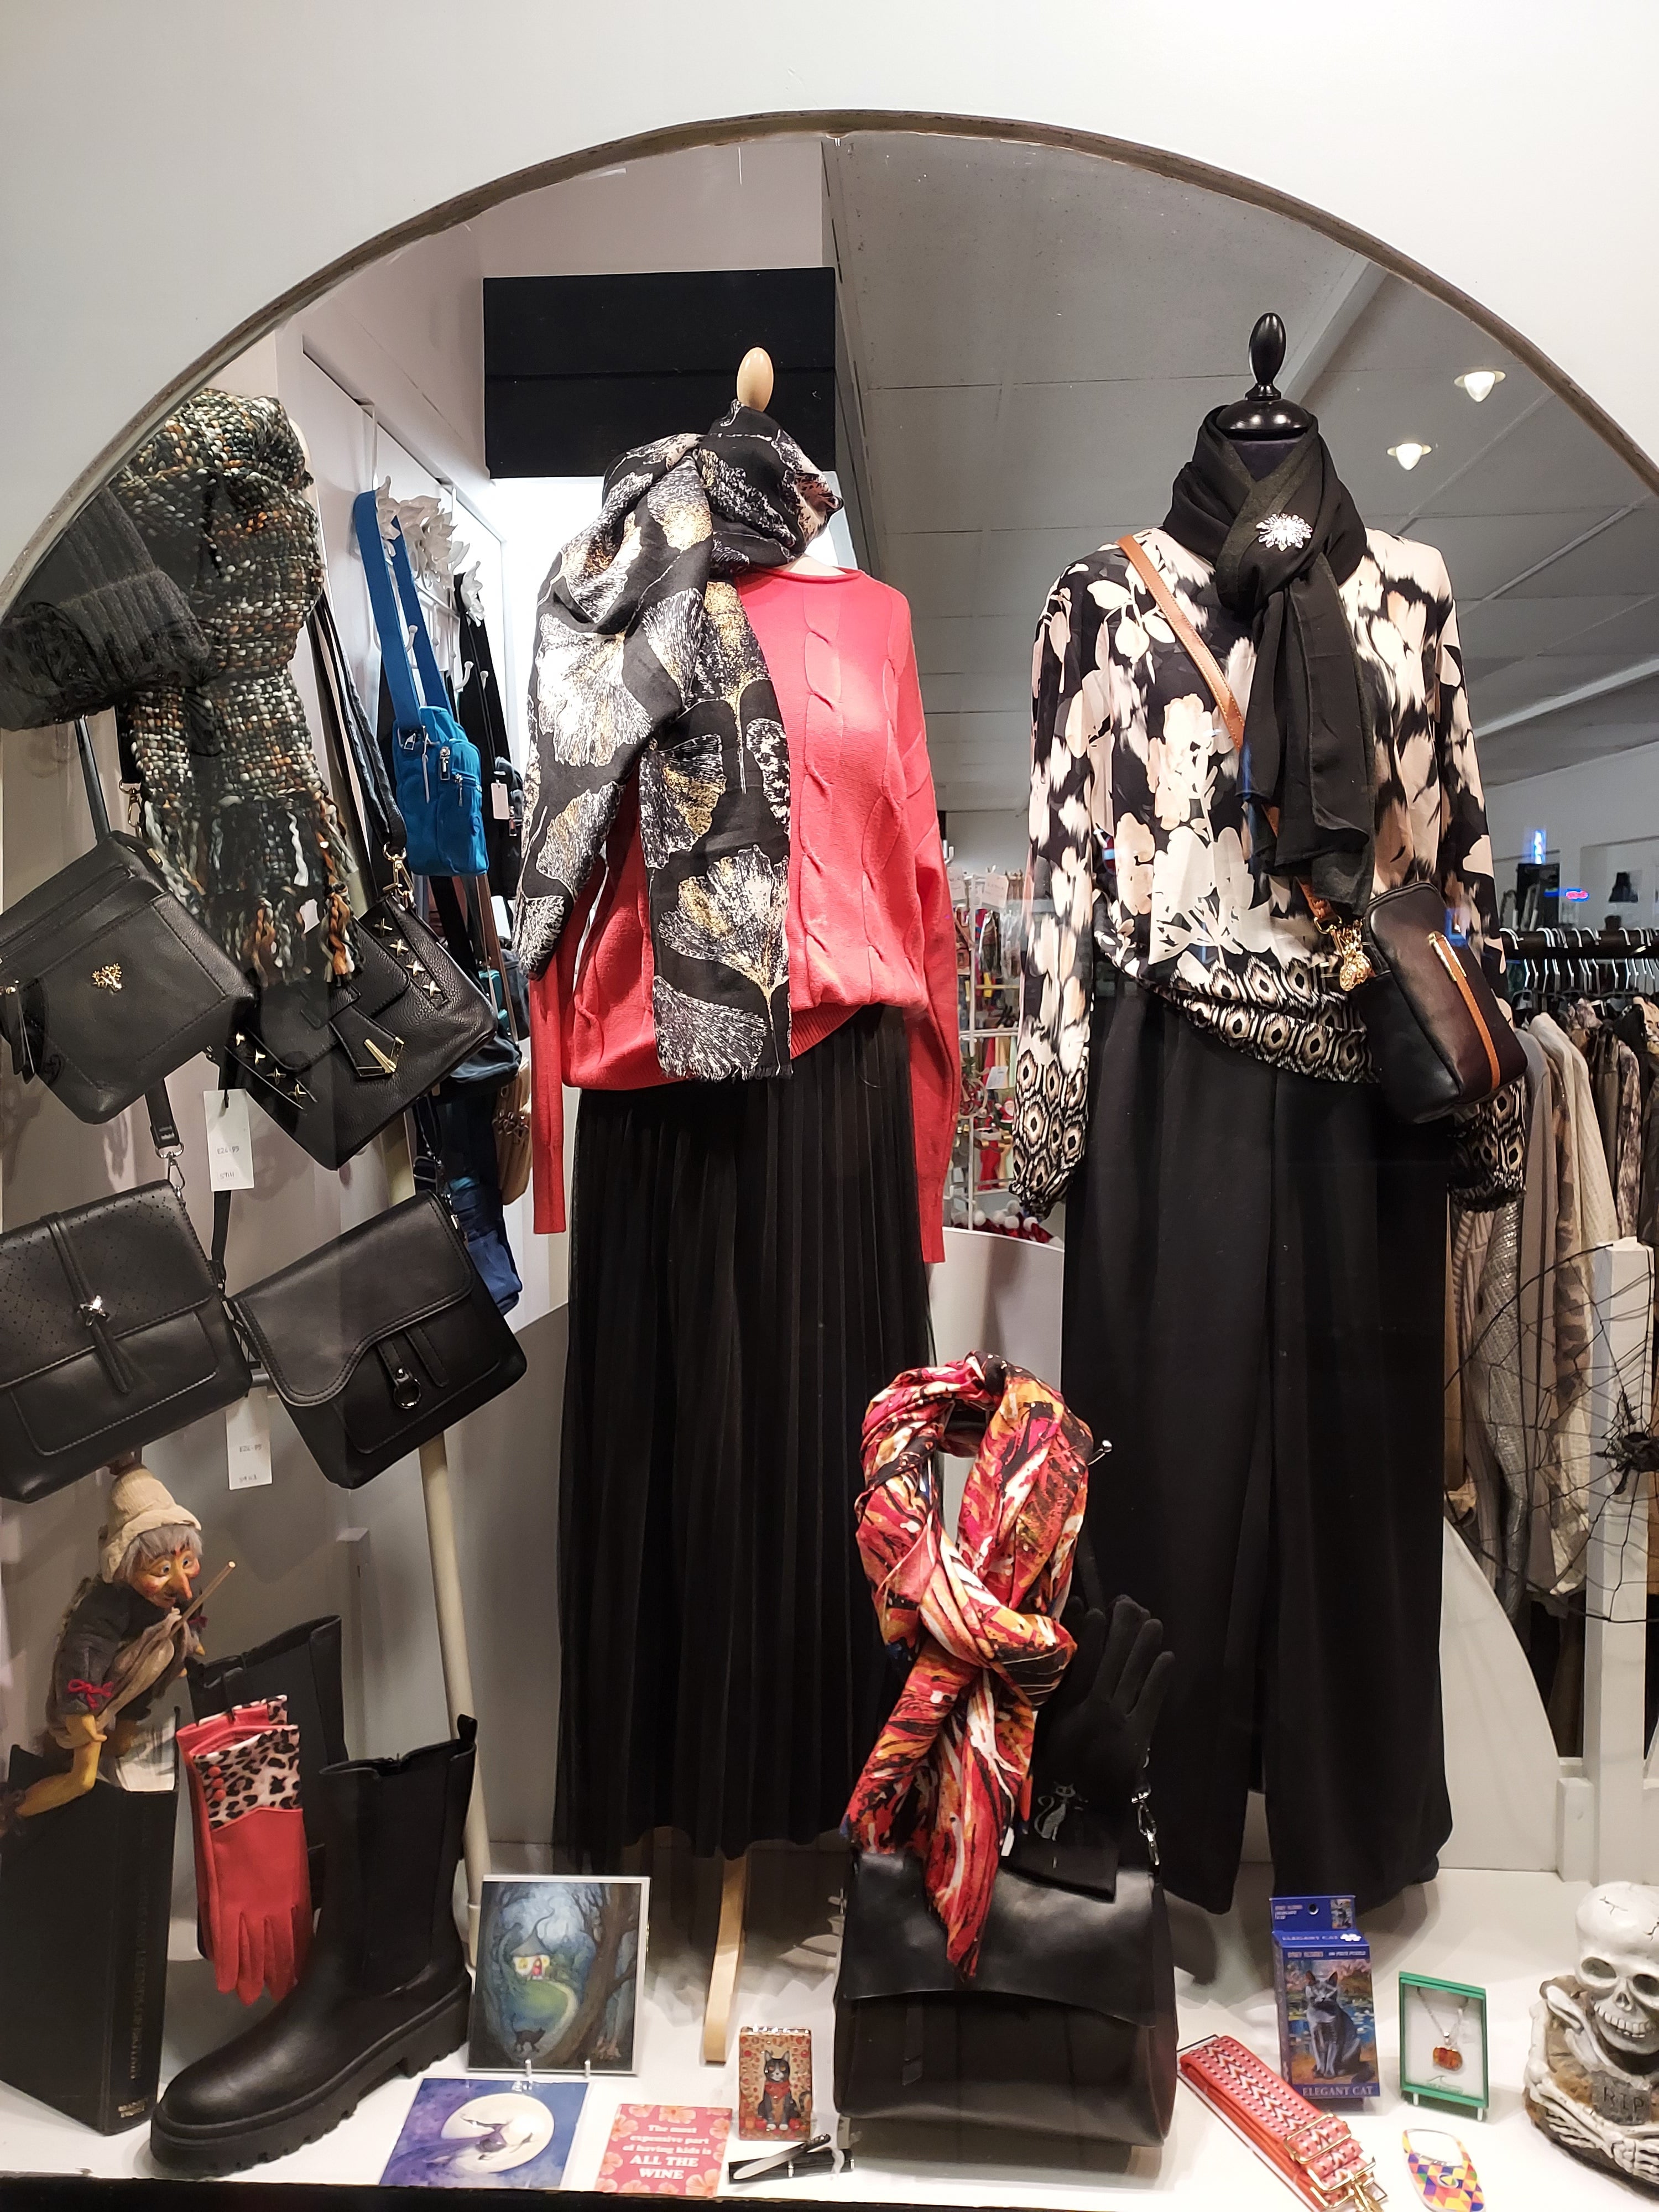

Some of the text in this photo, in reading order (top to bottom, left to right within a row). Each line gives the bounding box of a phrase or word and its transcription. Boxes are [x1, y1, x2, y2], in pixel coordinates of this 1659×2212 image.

[1302, 2085, 1373, 2096] ELEGANT CAT
[1604, 2086, 1645, 2114] RIP
[648, 2124, 669, 2132] The
[636, 2145, 675, 2154] having
[675, 2146, 701, 2154] kids
[629, 2154, 700, 2167] ALL THE
[638, 2167, 685, 2180] WINE
